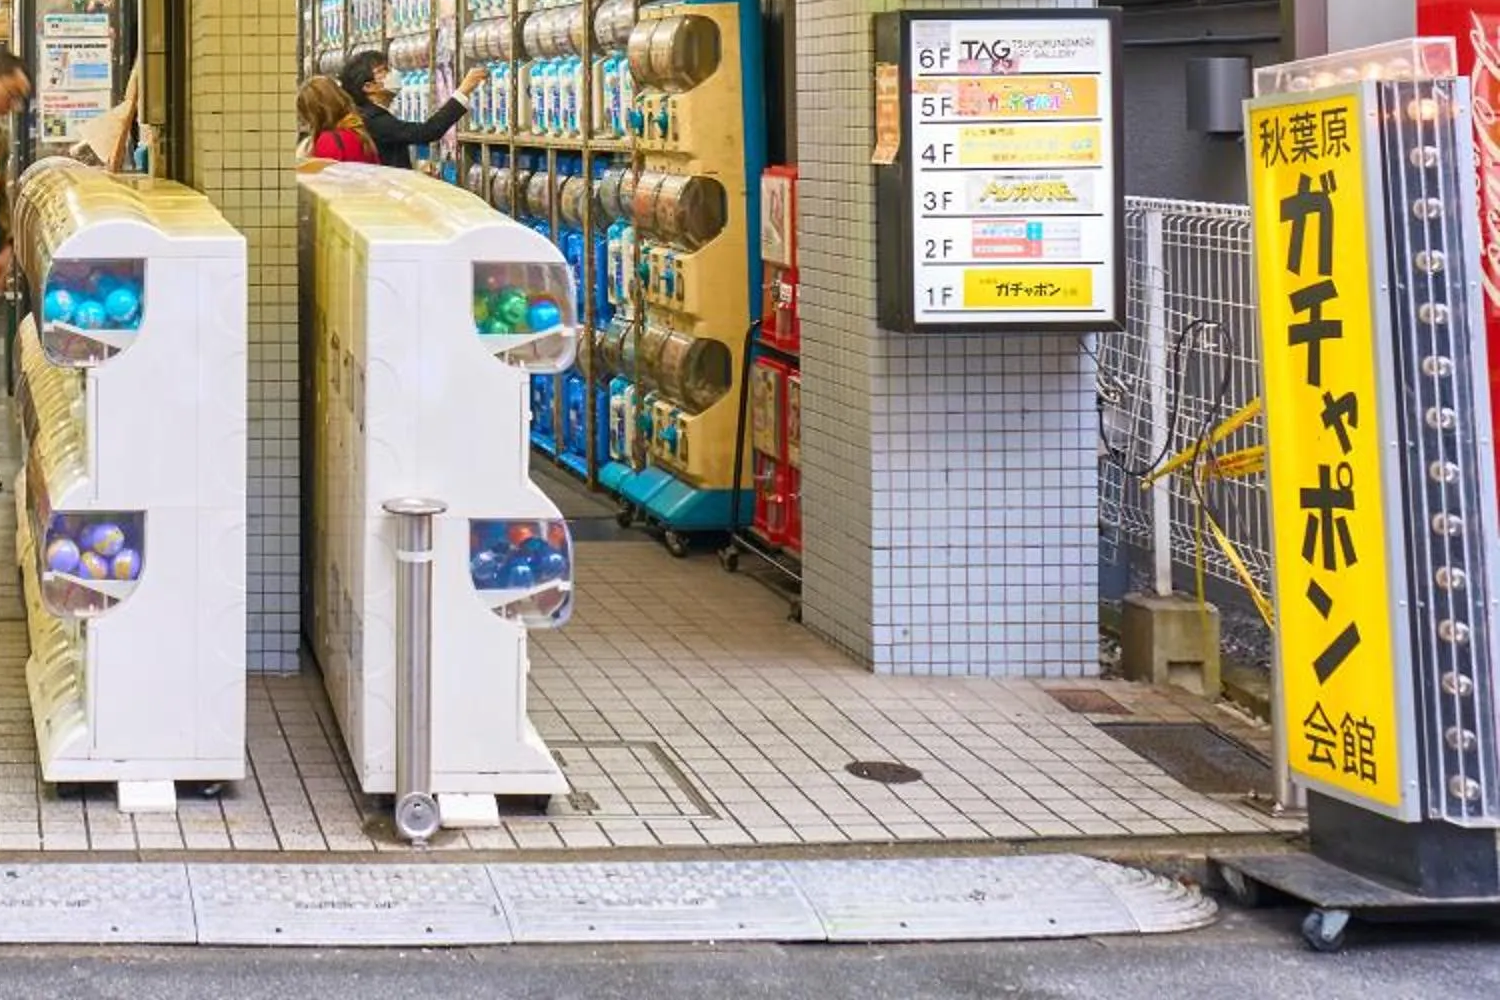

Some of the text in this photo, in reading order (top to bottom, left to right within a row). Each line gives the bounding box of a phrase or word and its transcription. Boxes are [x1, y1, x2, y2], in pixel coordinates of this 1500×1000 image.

[960, 39, 1011, 62] TAG
[1260, 107, 1351, 168] 秋葉原
[996, 281, 1061, 297] ガチャポン
[1280, 170, 1361, 685] ガチャポン
[1304, 702, 1376, 784] 会館
